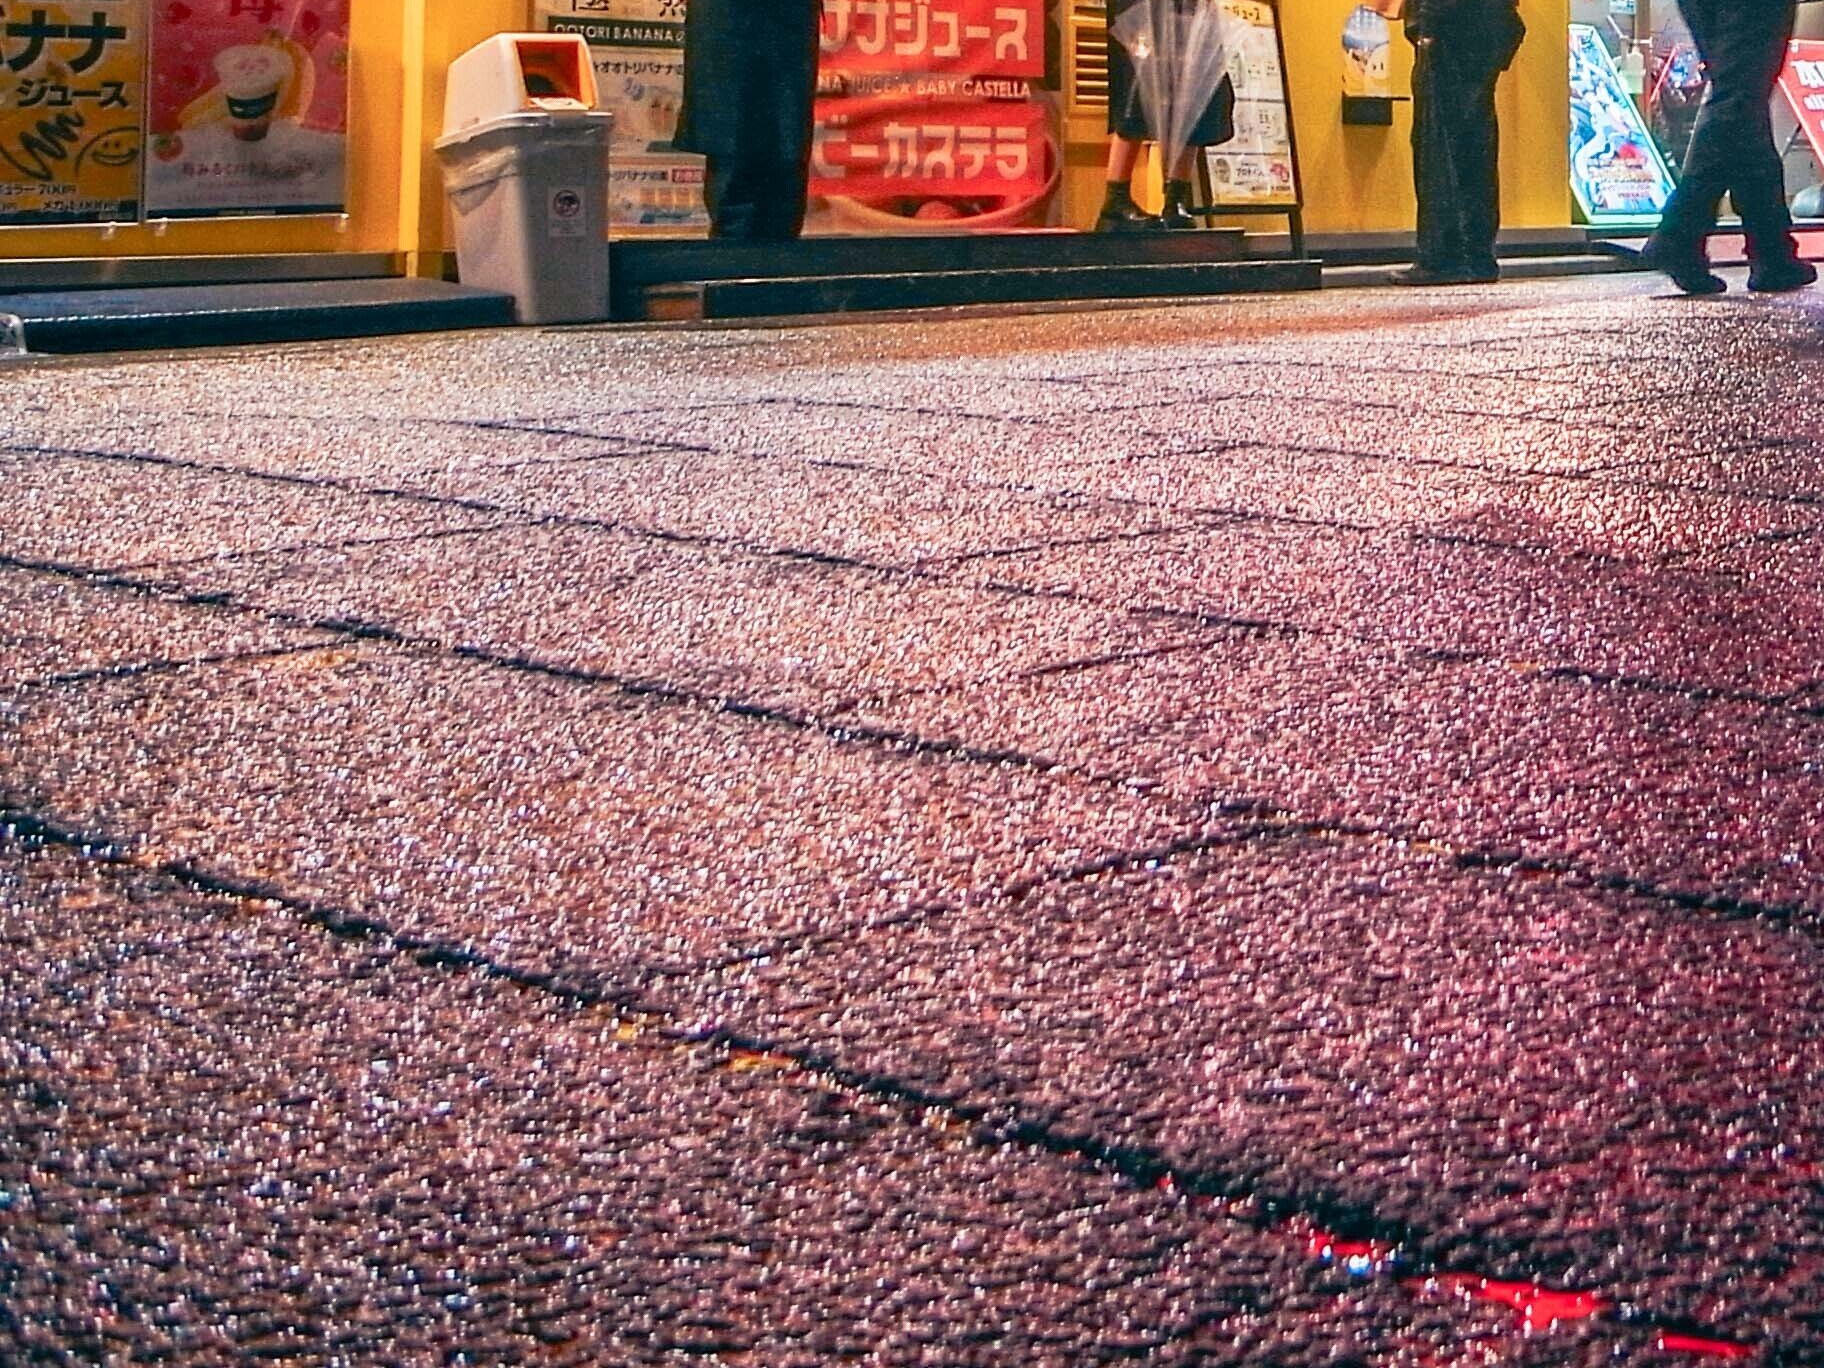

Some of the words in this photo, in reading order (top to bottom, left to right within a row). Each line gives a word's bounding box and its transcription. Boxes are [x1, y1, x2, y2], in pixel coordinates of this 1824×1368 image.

[0, 6, 126, 73] ナナ
[613, 27, 673, 41] BANANA
[16, 78, 128, 107] ジュース
[916, 81, 956, 95] BABY
[962, 81, 1031, 97] CASTELLA
